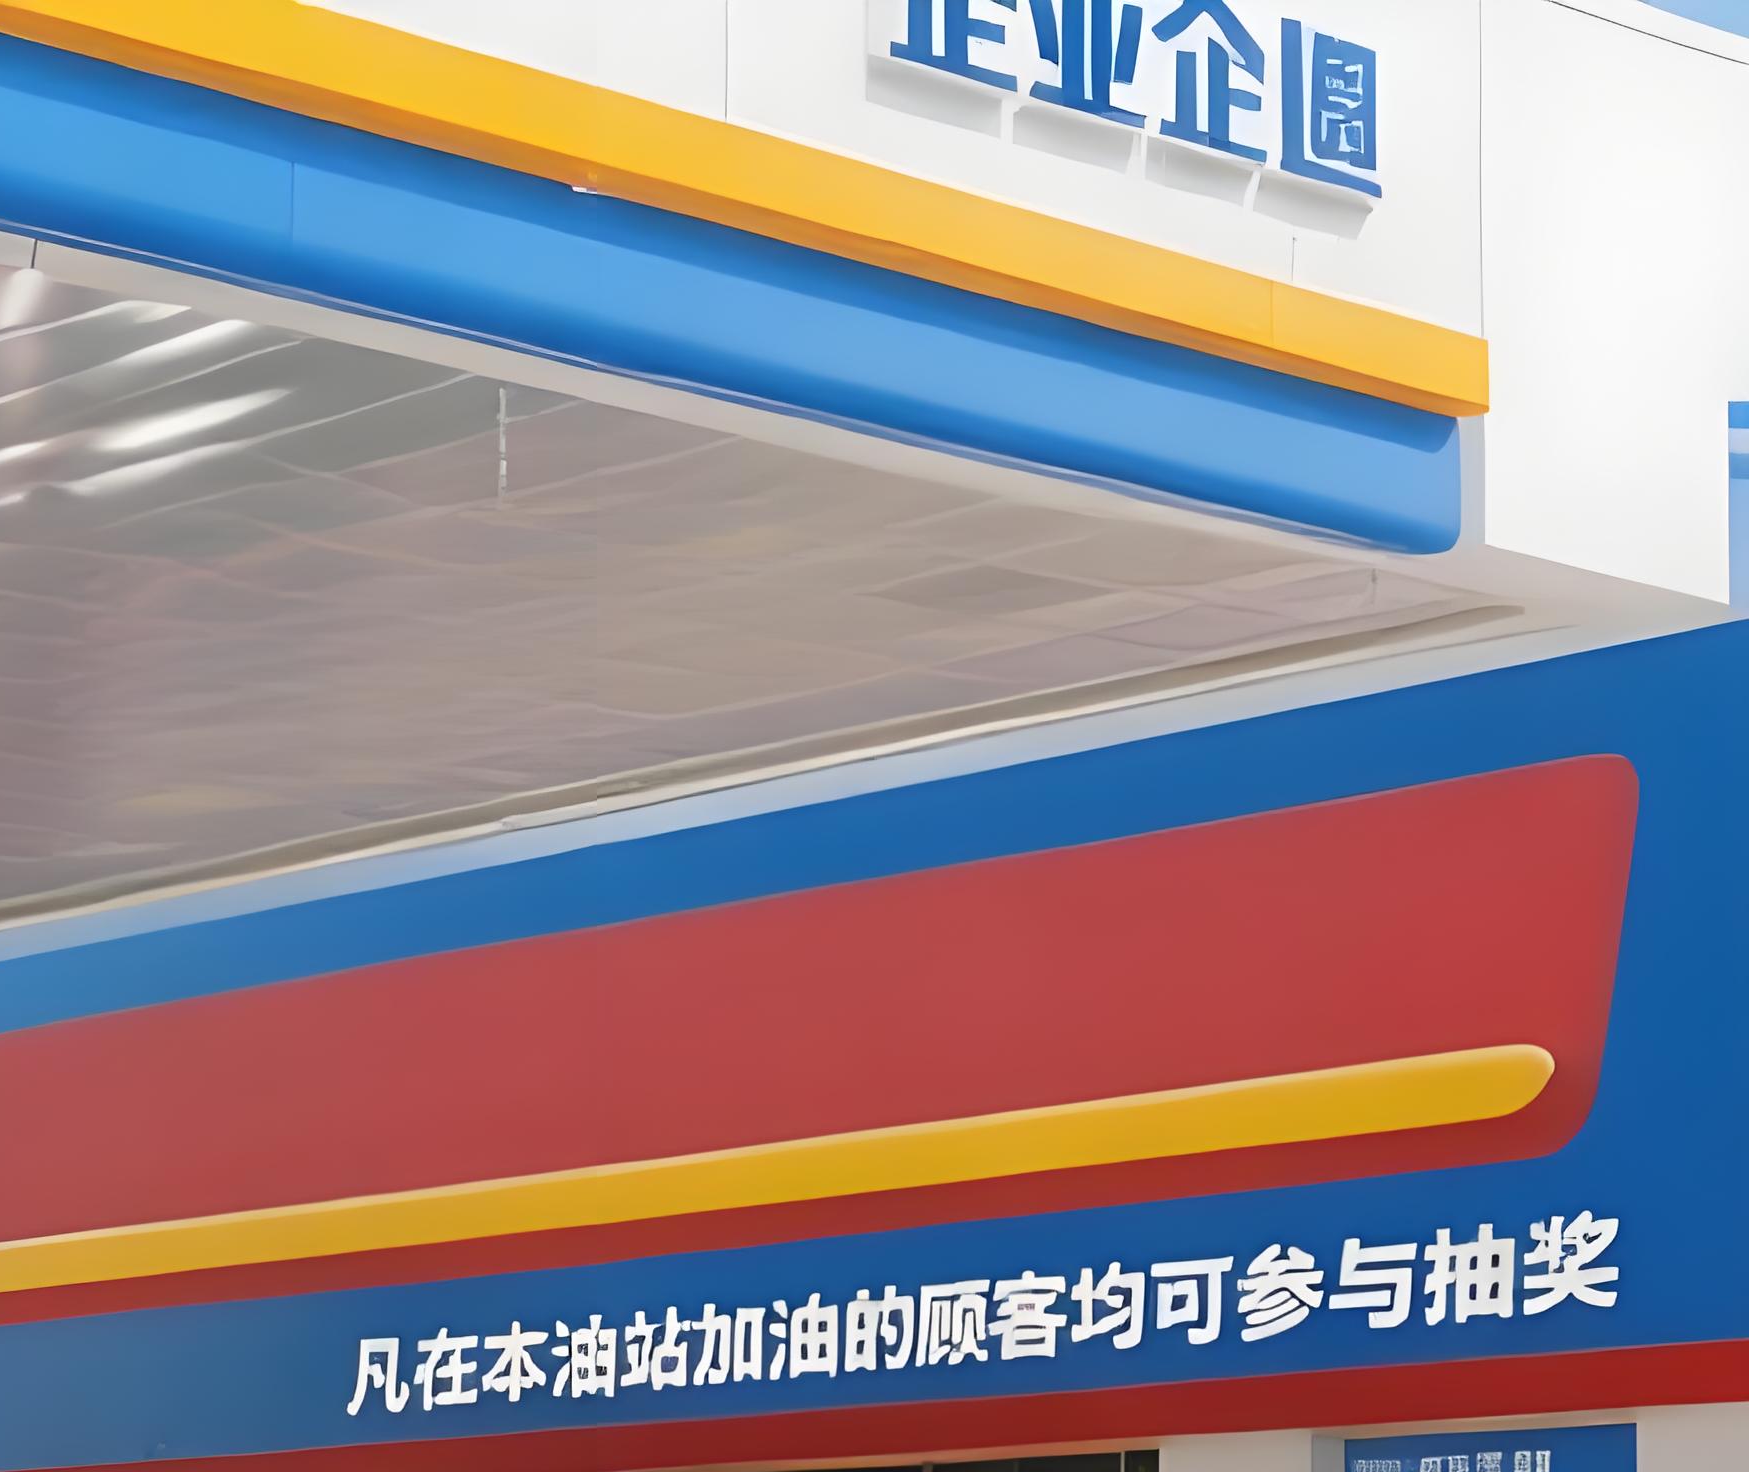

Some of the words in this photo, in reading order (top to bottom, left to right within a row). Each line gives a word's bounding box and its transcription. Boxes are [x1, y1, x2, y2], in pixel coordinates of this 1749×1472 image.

[346, 1210, 1620, 1416] 凡在本油站加油的顾客均可参与抽奖
